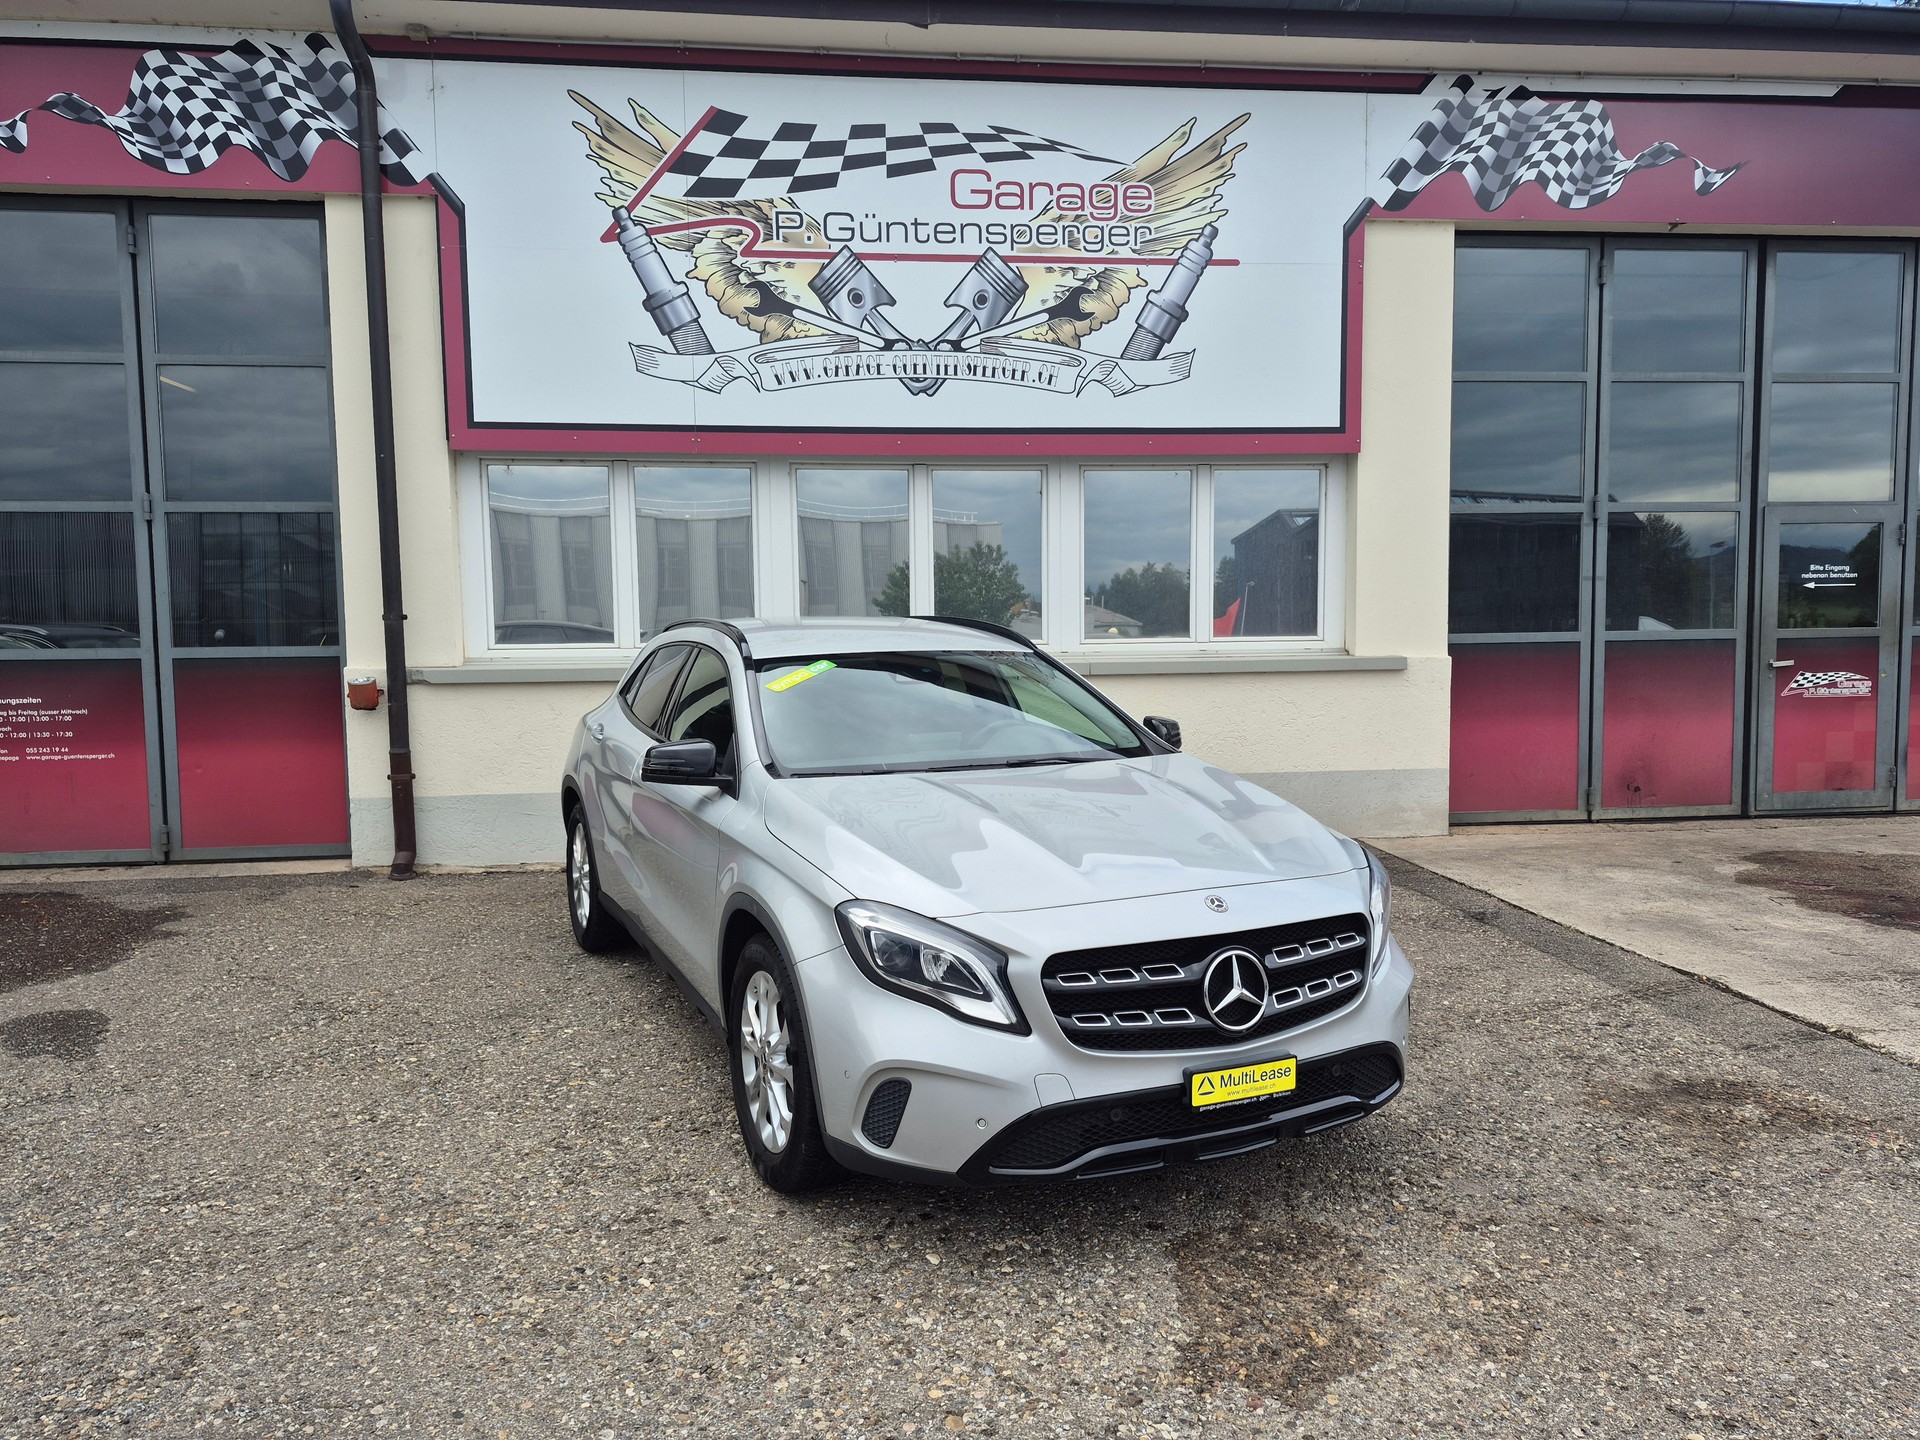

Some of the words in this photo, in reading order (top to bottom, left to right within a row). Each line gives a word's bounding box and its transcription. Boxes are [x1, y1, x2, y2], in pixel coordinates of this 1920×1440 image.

[950, 168, 1153, 222] Garage
[770, 354, 1060, 388] WWW.GARAGE-GUENTENSPERGER.CH
[1825, 564, 1850, 572] Eingang
[26, 753, 115, 761] www.garage-guentensperger.ch
[1220, 1066, 1292, 1088] MultiLease
[1226, 1083, 1277, 1097] www.multilease.ch
